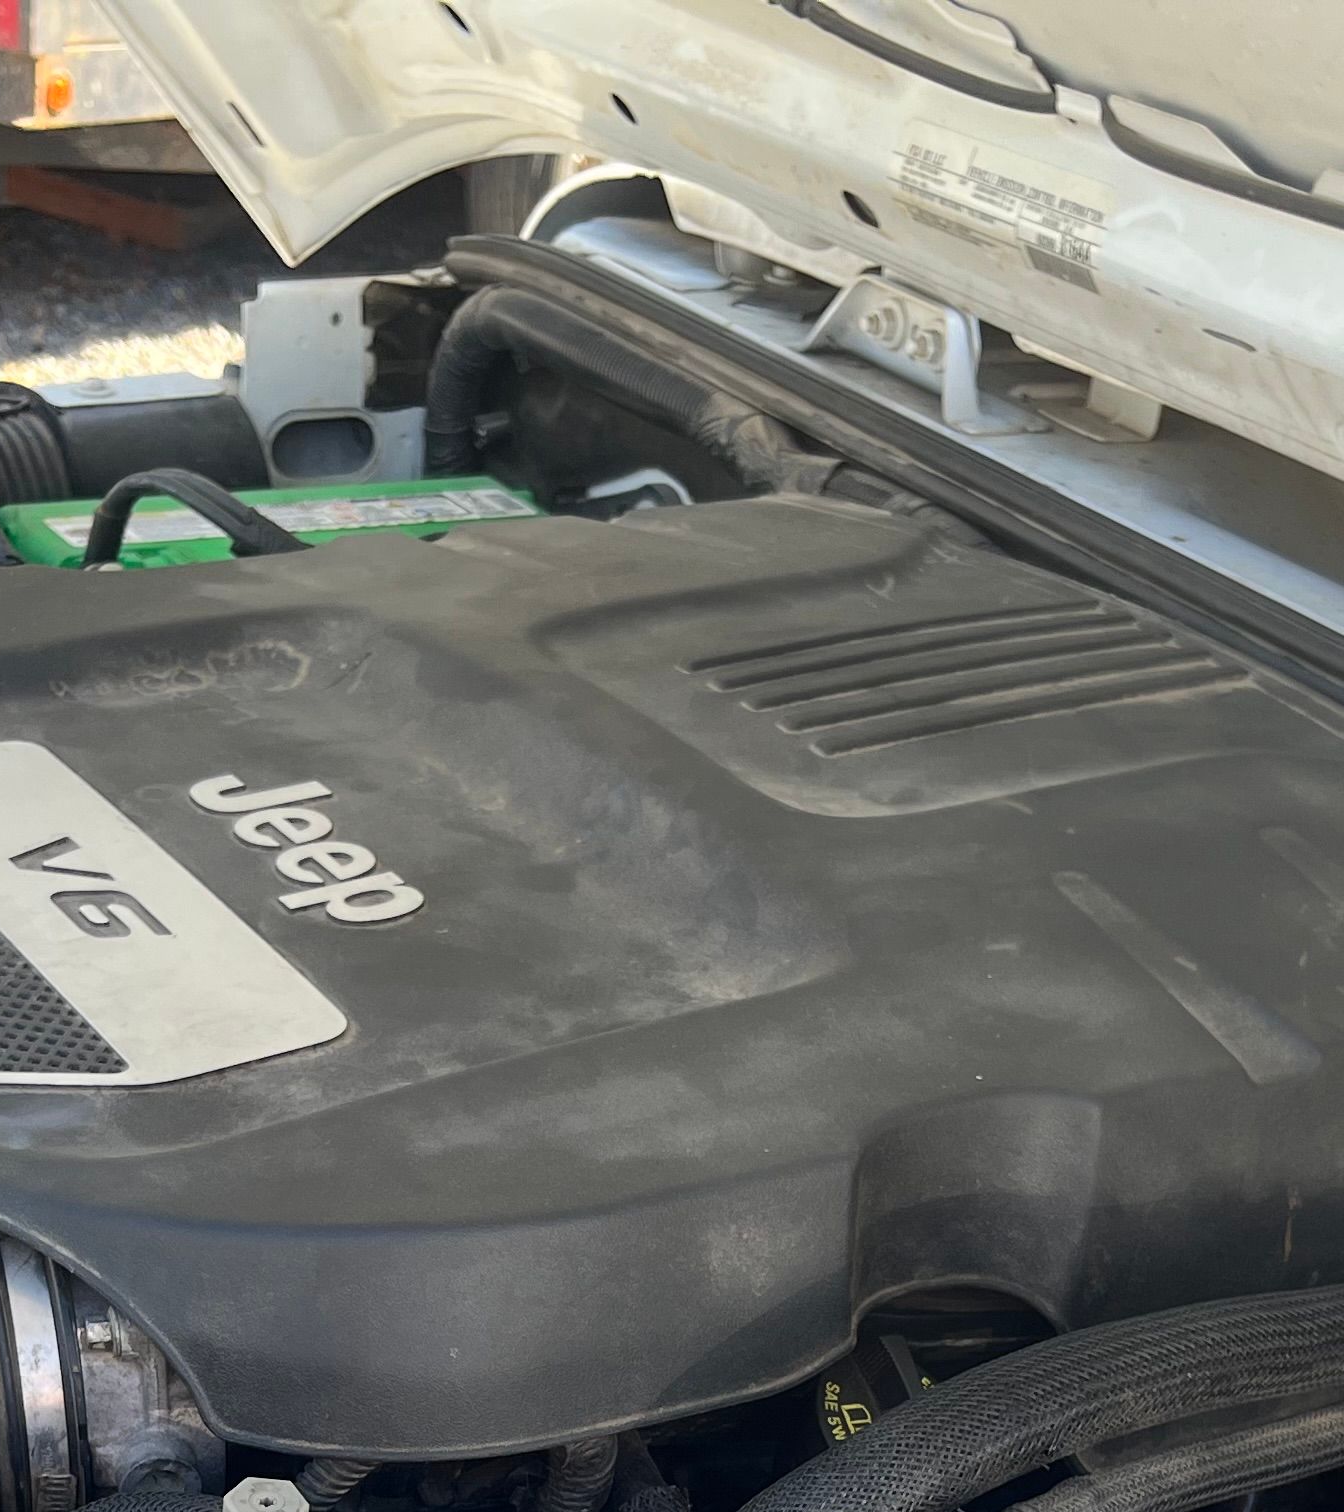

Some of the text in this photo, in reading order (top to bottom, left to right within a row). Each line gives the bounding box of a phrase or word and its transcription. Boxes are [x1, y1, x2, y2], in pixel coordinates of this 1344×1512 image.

[8, 835, 176, 940] V6
[188, 774, 425, 924] Jeep
[824, 1381, 840, 1412] SAE
